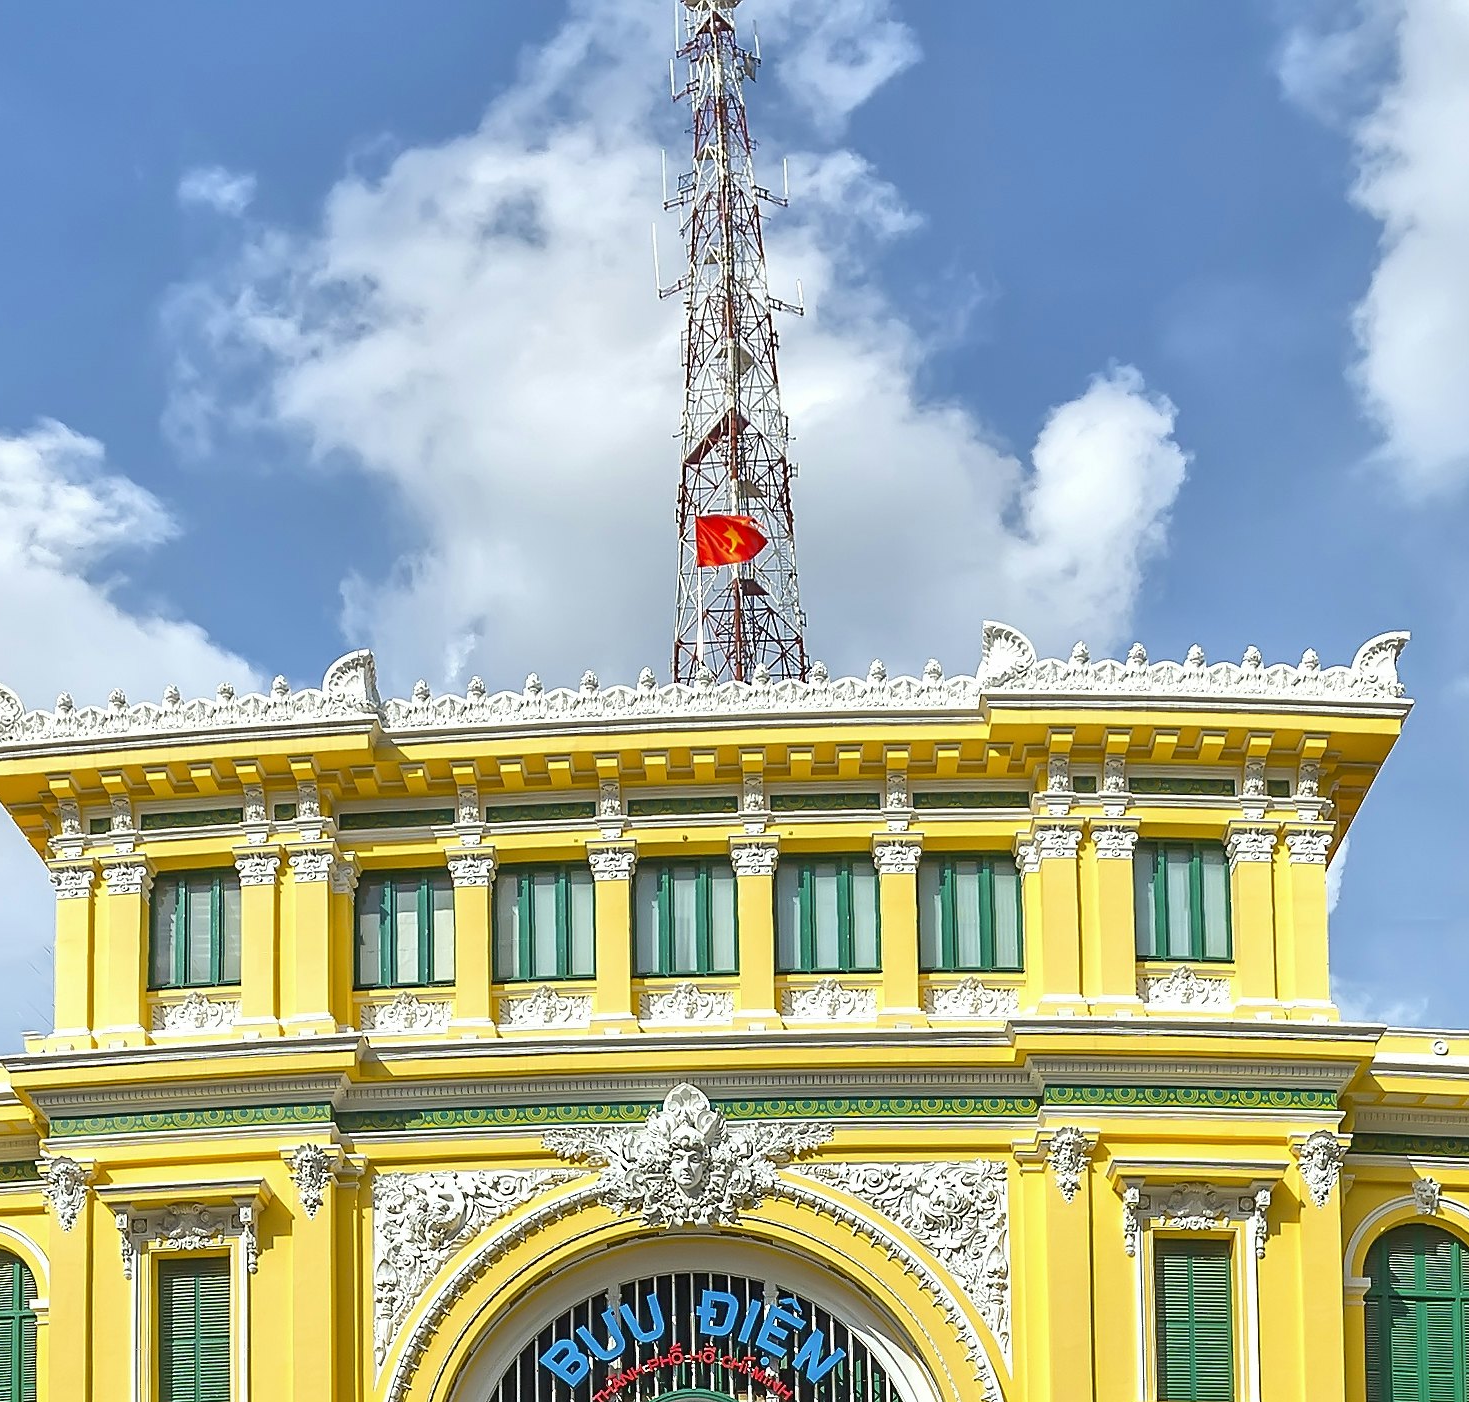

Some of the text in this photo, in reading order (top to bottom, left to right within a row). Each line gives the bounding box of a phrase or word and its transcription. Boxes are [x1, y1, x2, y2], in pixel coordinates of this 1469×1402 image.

[539, 1289, 846, 1388] BƯU ĐIỆN
[647, 1342, 684, 1372] PHỐ
[689, 1343, 717, 1364] HỒ
[721, 1356, 756, 1375] CHÍ
[750, 1366, 793, 1401] MINH
